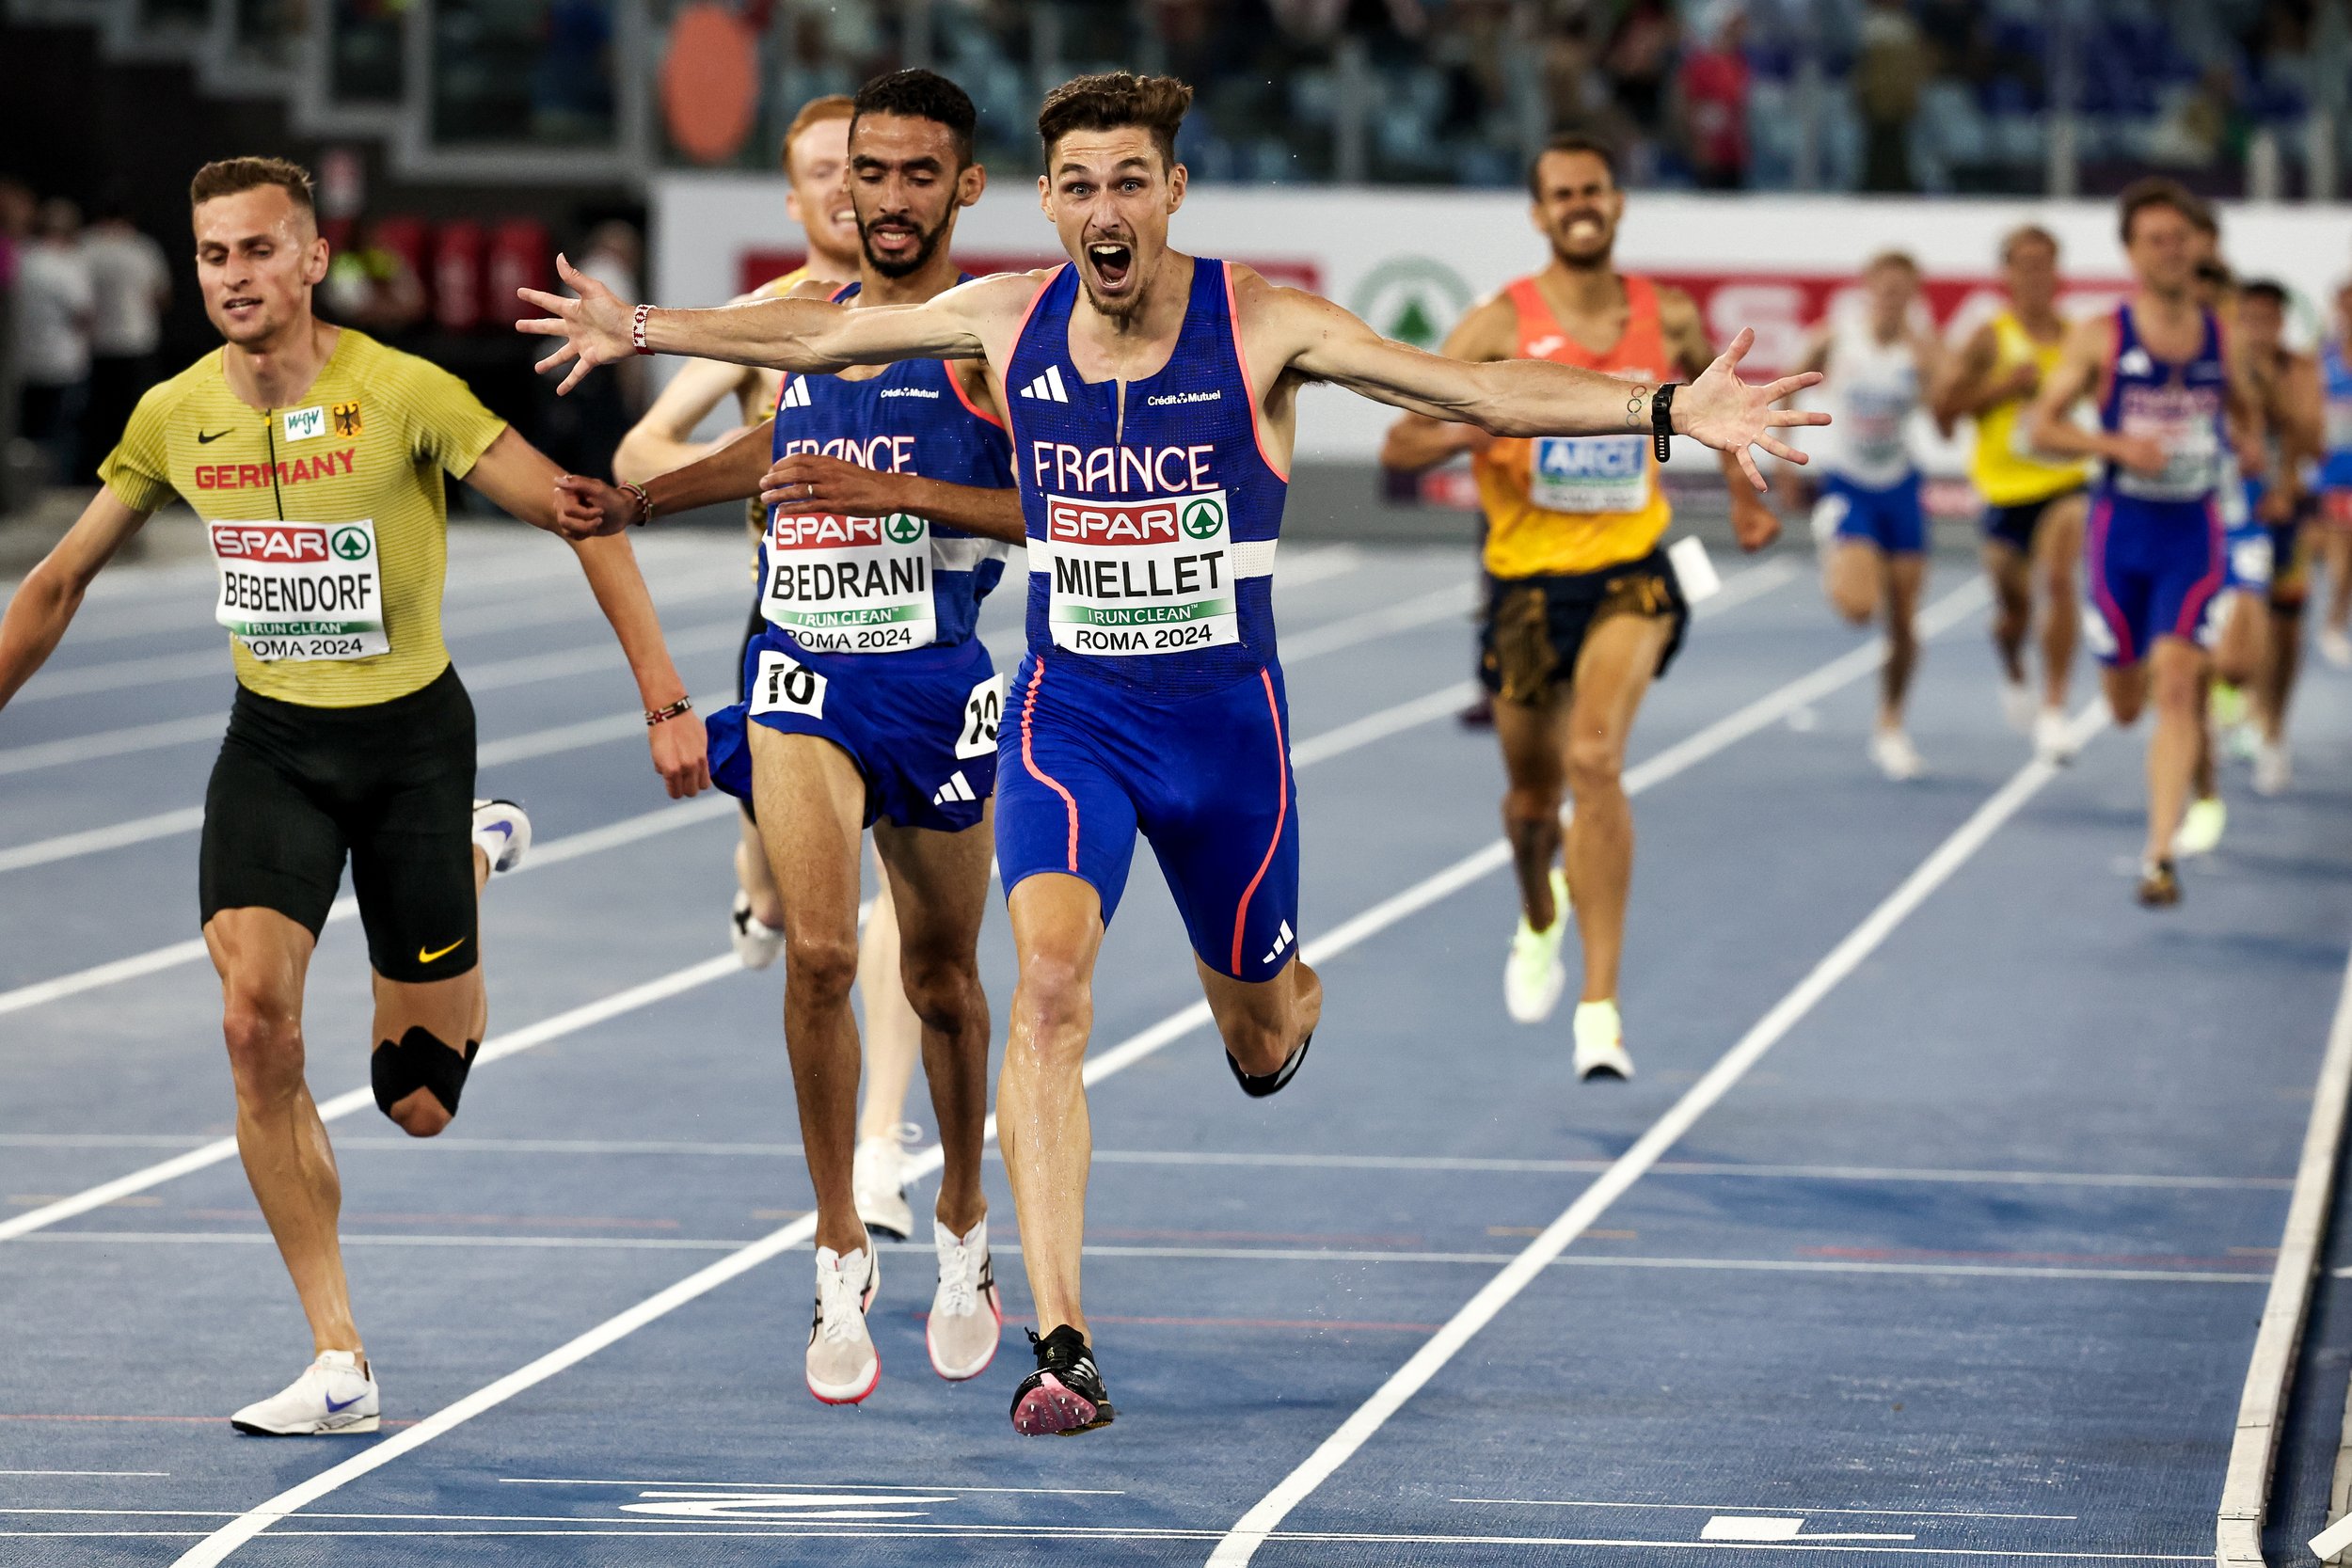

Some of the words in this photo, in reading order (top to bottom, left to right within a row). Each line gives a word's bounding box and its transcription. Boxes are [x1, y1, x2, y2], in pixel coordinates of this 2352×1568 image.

[909, 388, 939, 399] Mutuel
[1147, 394, 1177, 406] Crédit
[1187, 389, 1221, 403] Mutuel
[195, 448, 356, 489] GERMANY
[1033, 440, 1219, 493] FRANCE
[777, 515, 879, 546] SPAR
[1054, 507, 1175, 540] SPAR
[215, 529, 326, 559] SPAR
[771, 556, 926, 601] BEDRANI
[1055, 550, 1224, 599] MIELLET
[225, 571, 372, 612] BEBENDORF
[253, 622, 287, 634] RUN
[805, 612, 838, 626] RUN
[1094, 610, 1131, 625] RUN
[247, 640, 307, 657] OMA
[310, 638, 364, 656] 2024
[857, 627, 913, 649] 2024
[1075, 629, 1150, 651] ROMA
[1154, 624, 1213, 649] 2024
[768, 663, 816, 705] 10
